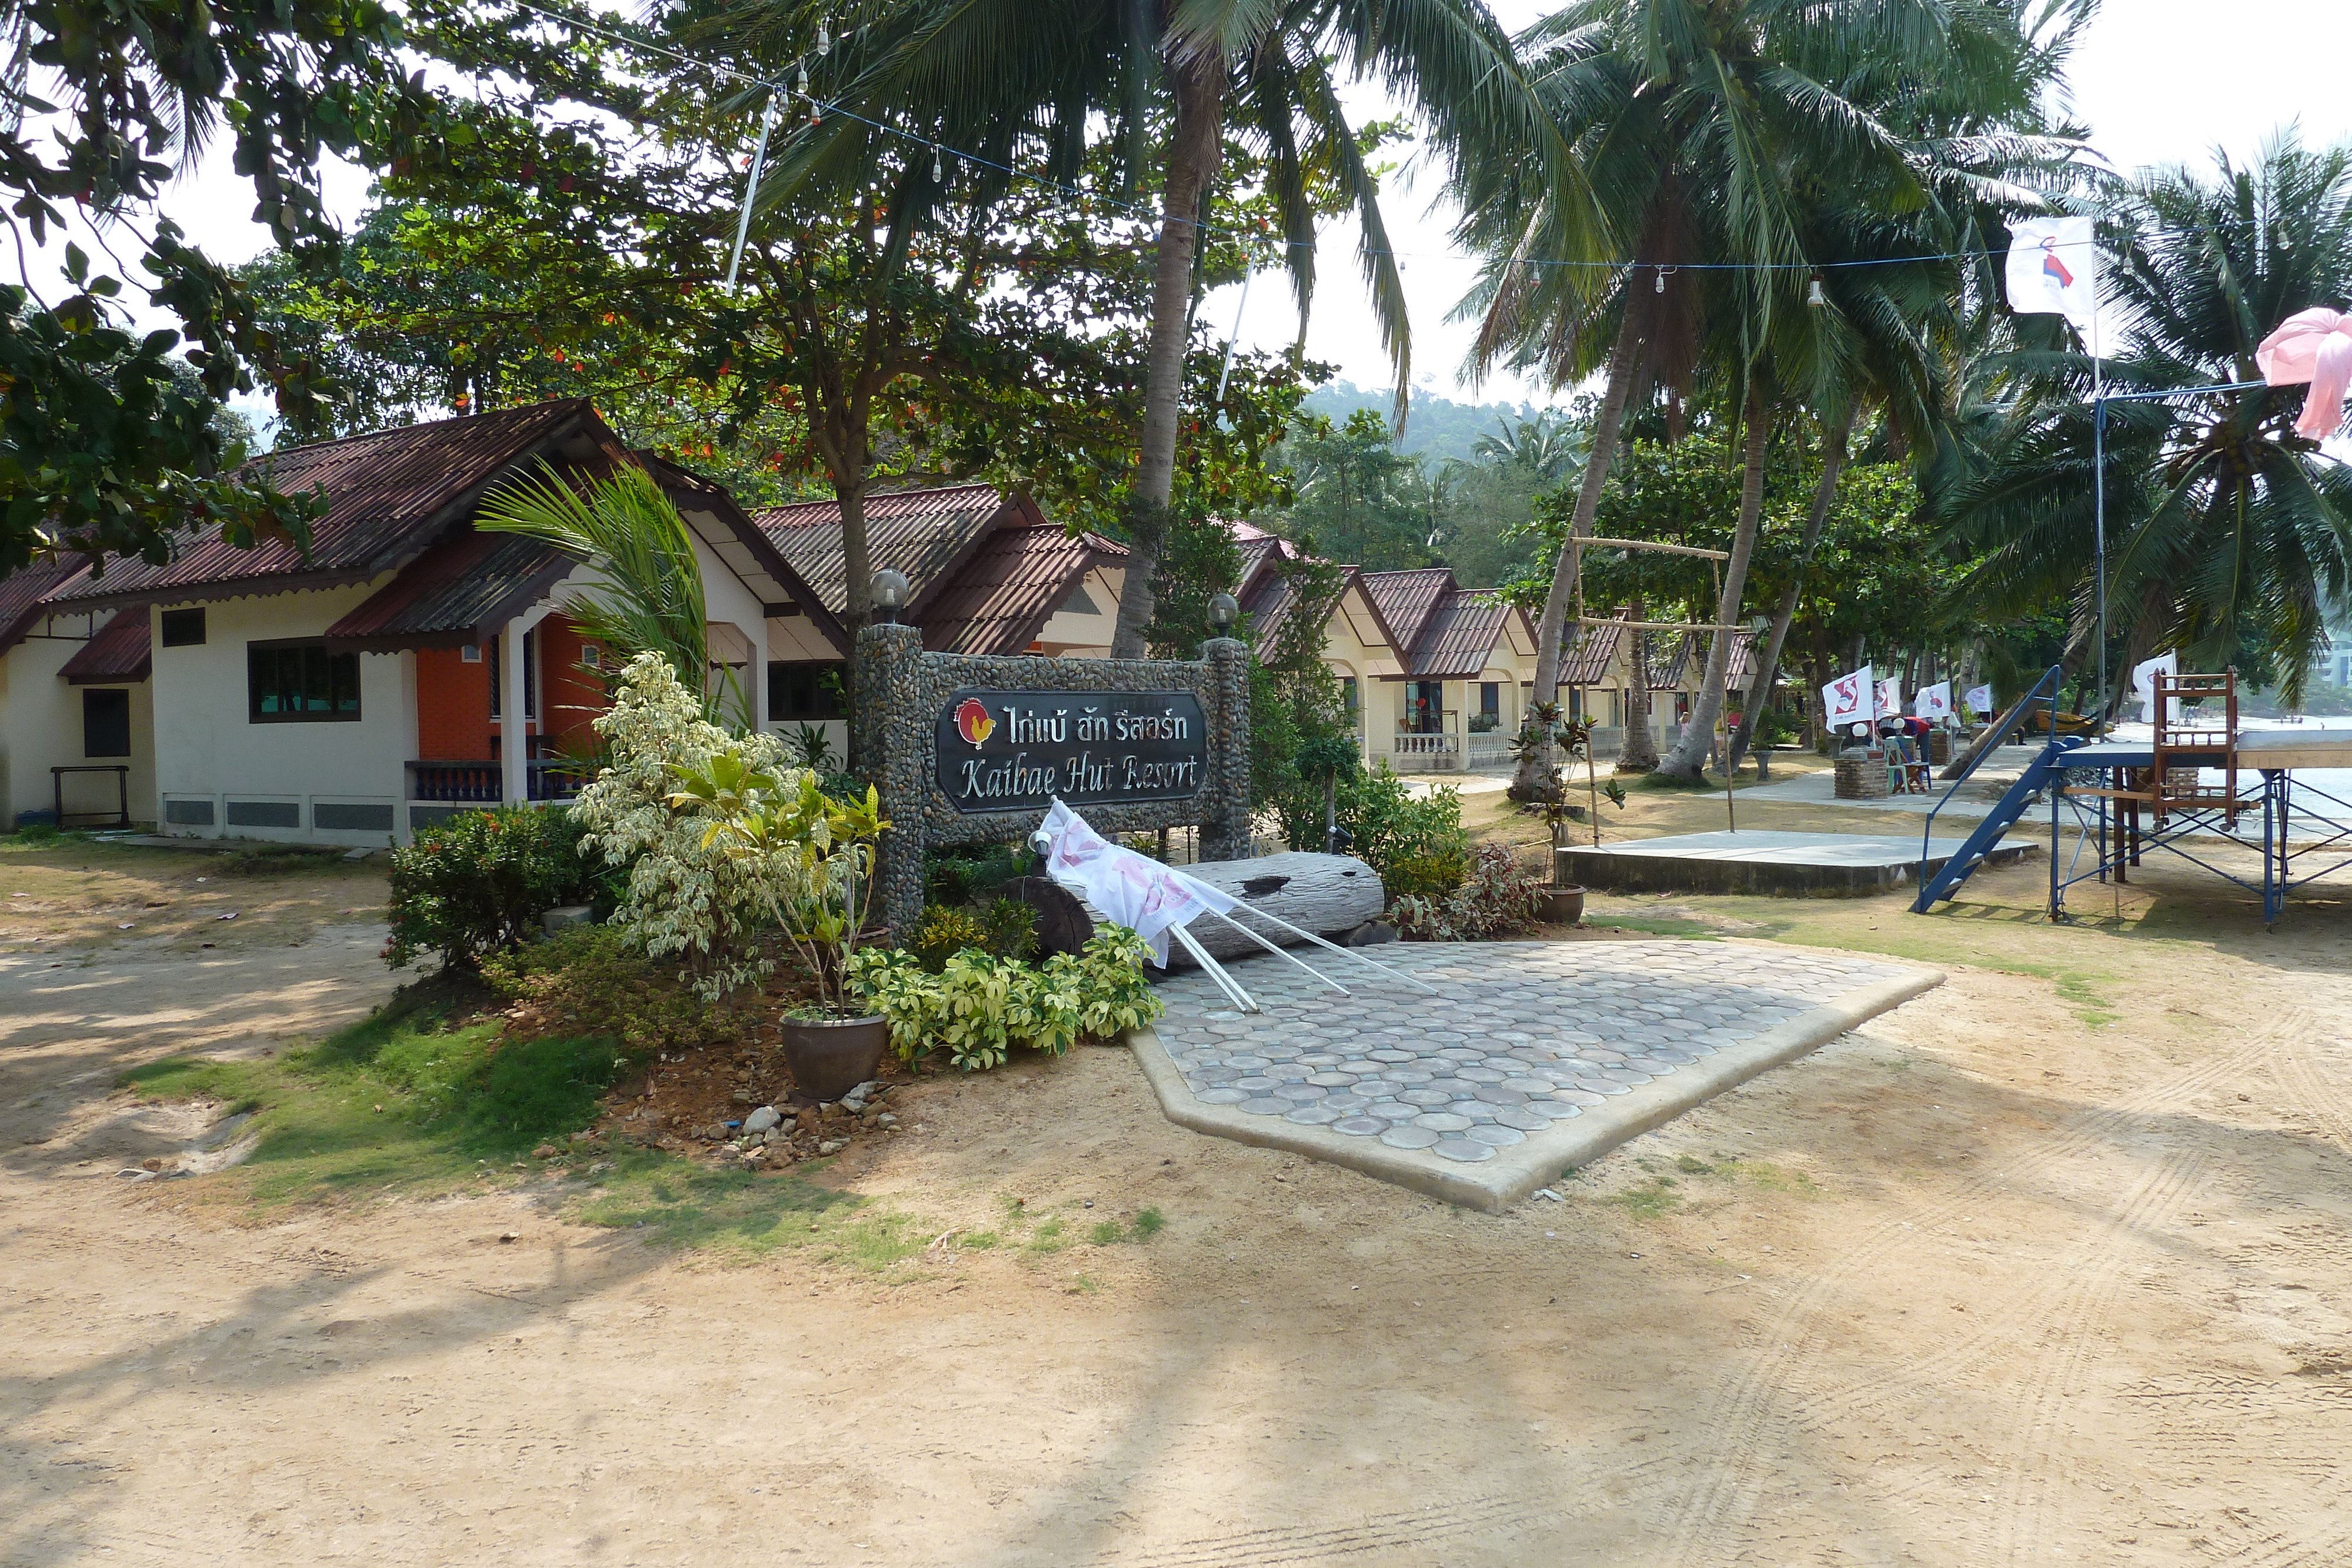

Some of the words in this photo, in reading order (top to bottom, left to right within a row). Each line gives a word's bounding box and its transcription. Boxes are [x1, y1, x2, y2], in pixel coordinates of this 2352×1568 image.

[1003, 706, 1067, 743] ไก่แบ้
[959, 752, 1055, 798] Kaibae
[1063, 750, 1114, 793] Hut
[1121, 755, 1197, 790] Resort
